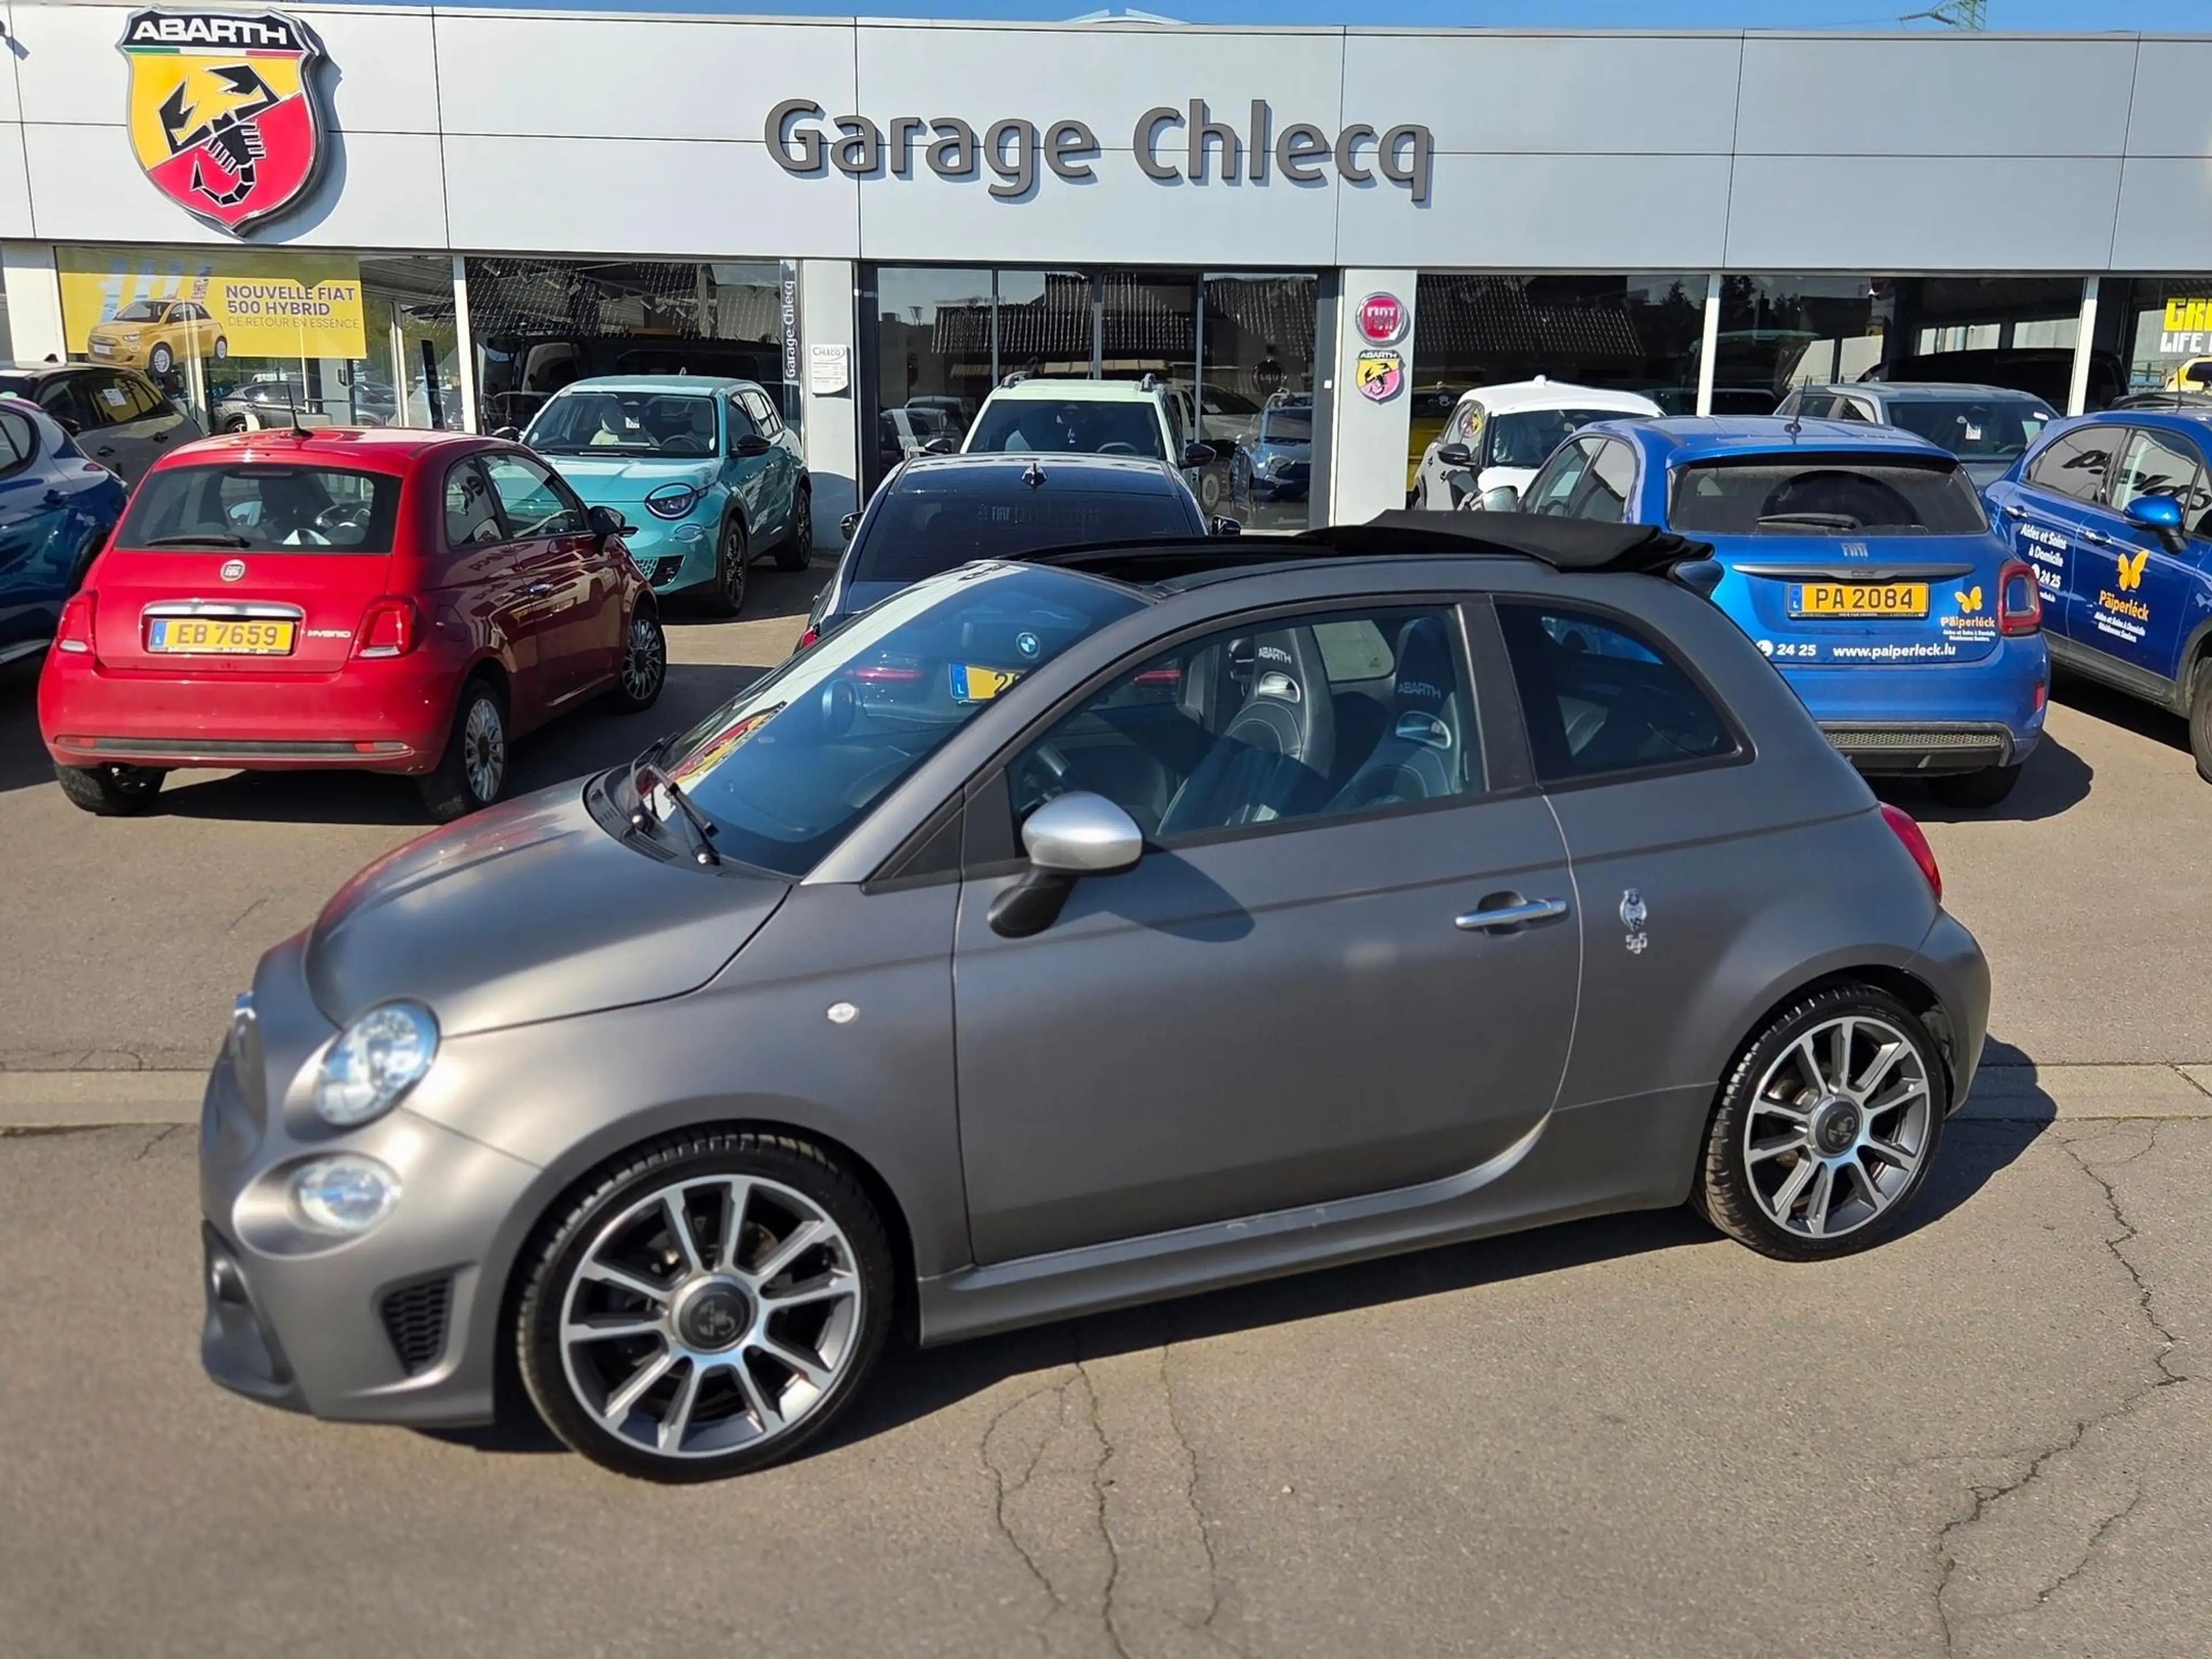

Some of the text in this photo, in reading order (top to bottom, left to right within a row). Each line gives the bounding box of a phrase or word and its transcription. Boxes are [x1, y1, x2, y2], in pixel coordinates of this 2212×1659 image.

[132, 18, 287, 44] ABARTH
[764, 98, 1431, 203] Garage Chlecq
[226, 285, 355, 301] NOUVELLE FIAT
[228, 301, 330, 316] 500 HYBRID
[1367, 306, 1396, 317] FIAT
[228, 316, 359, 329] DE RETOUR EN ESSENCE
[783, 280, 798, 378] Garage Chlecq
[2160, 332, 2204, 353] LIFE
[1359, 351, 1397, 359] ABARTH
[1816, 588, 1912, 609] PA 2084
[2099, 589, 2150, 622] Päiperléck
[176, 624, 278, 646] EB 7659
[1257, 646, 1292, 664] ABARTH
[1777, 643, 1817, 657] 24 25
[1832, 642, 1957, 660] www.paiperleck.lu
[957, 684, 965, 694] L
[1397, 681, 1441, 699] ABARTH
